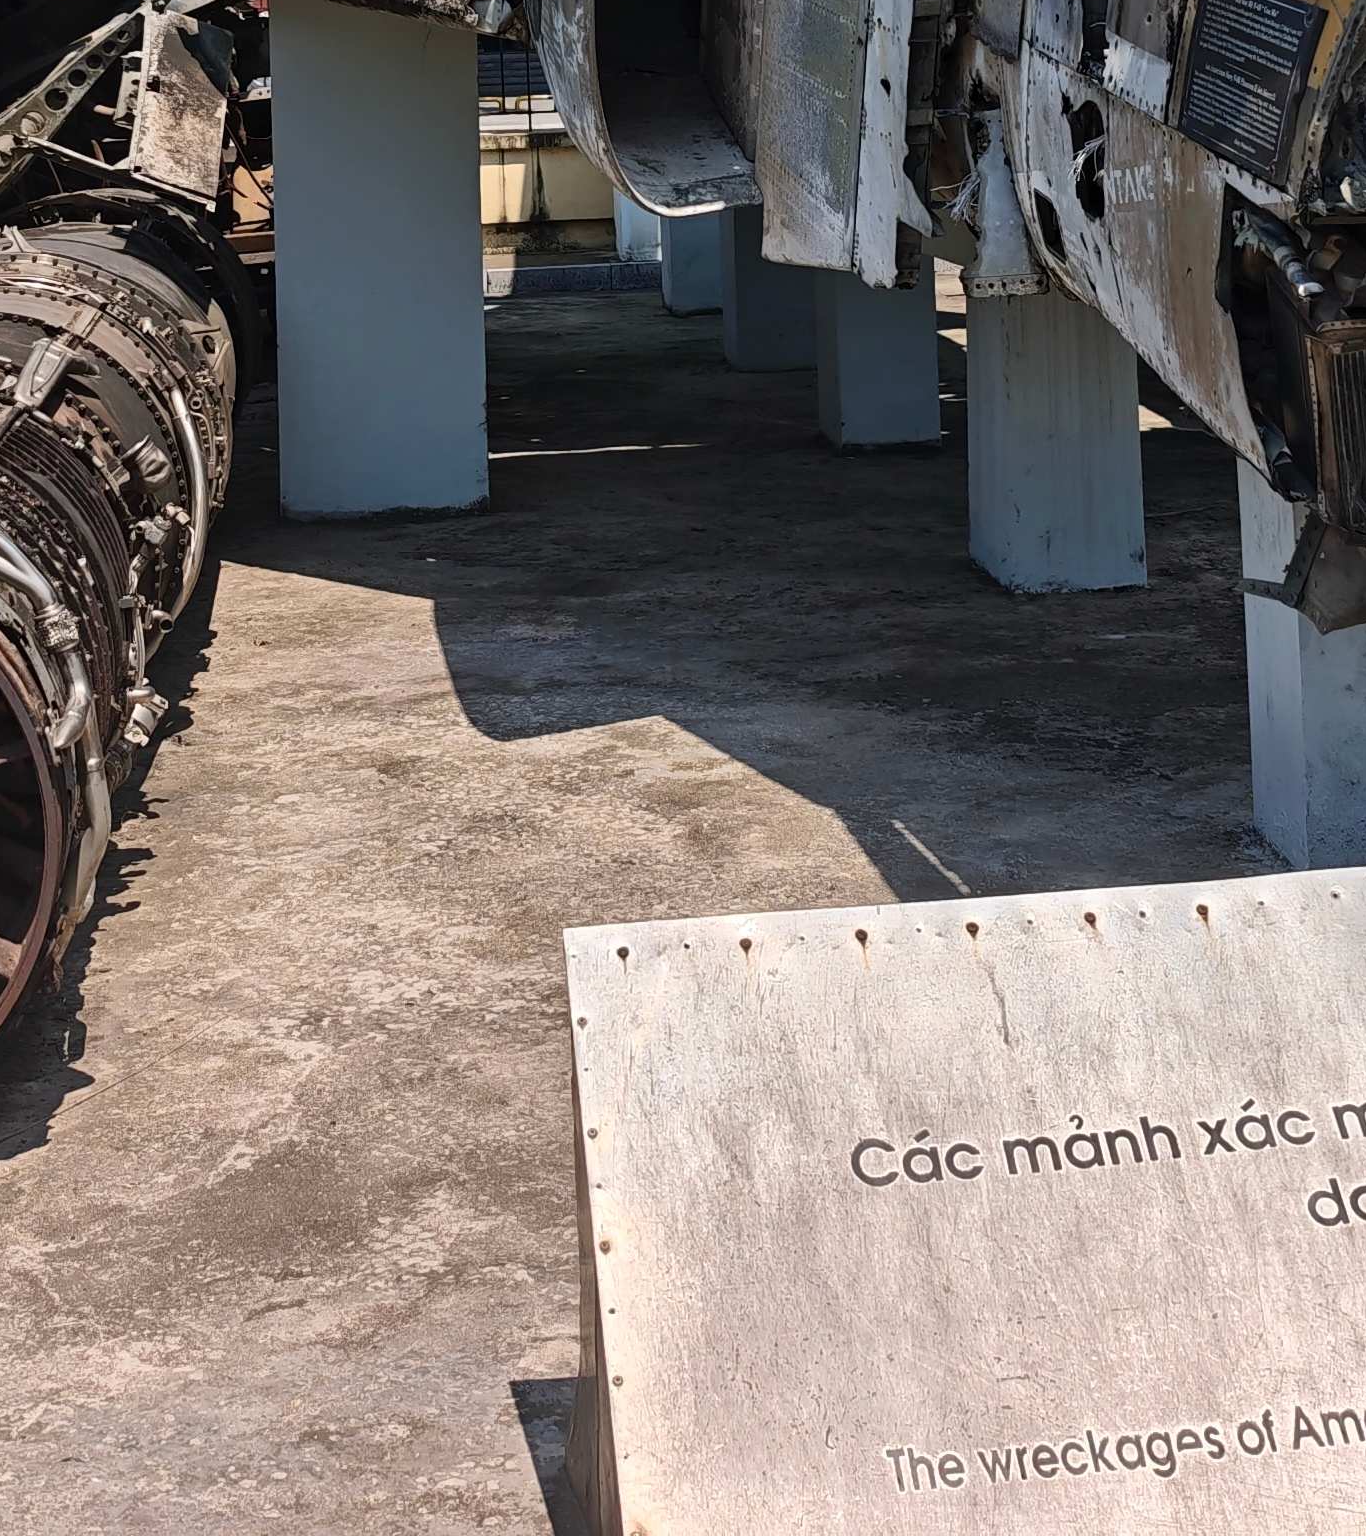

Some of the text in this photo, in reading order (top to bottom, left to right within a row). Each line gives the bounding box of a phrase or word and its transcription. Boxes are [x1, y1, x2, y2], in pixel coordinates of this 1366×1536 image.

[851, 1130, 983, 1186] Các
[1003, 1115, 1181, 1174] mảnh
[1197, 1099, 1315, 1155] xác
[886, 1448, 964, 1491] The
[978, 1427, 1225, 1483] wreckages
[1237, 1410, 1277, 1455] of
